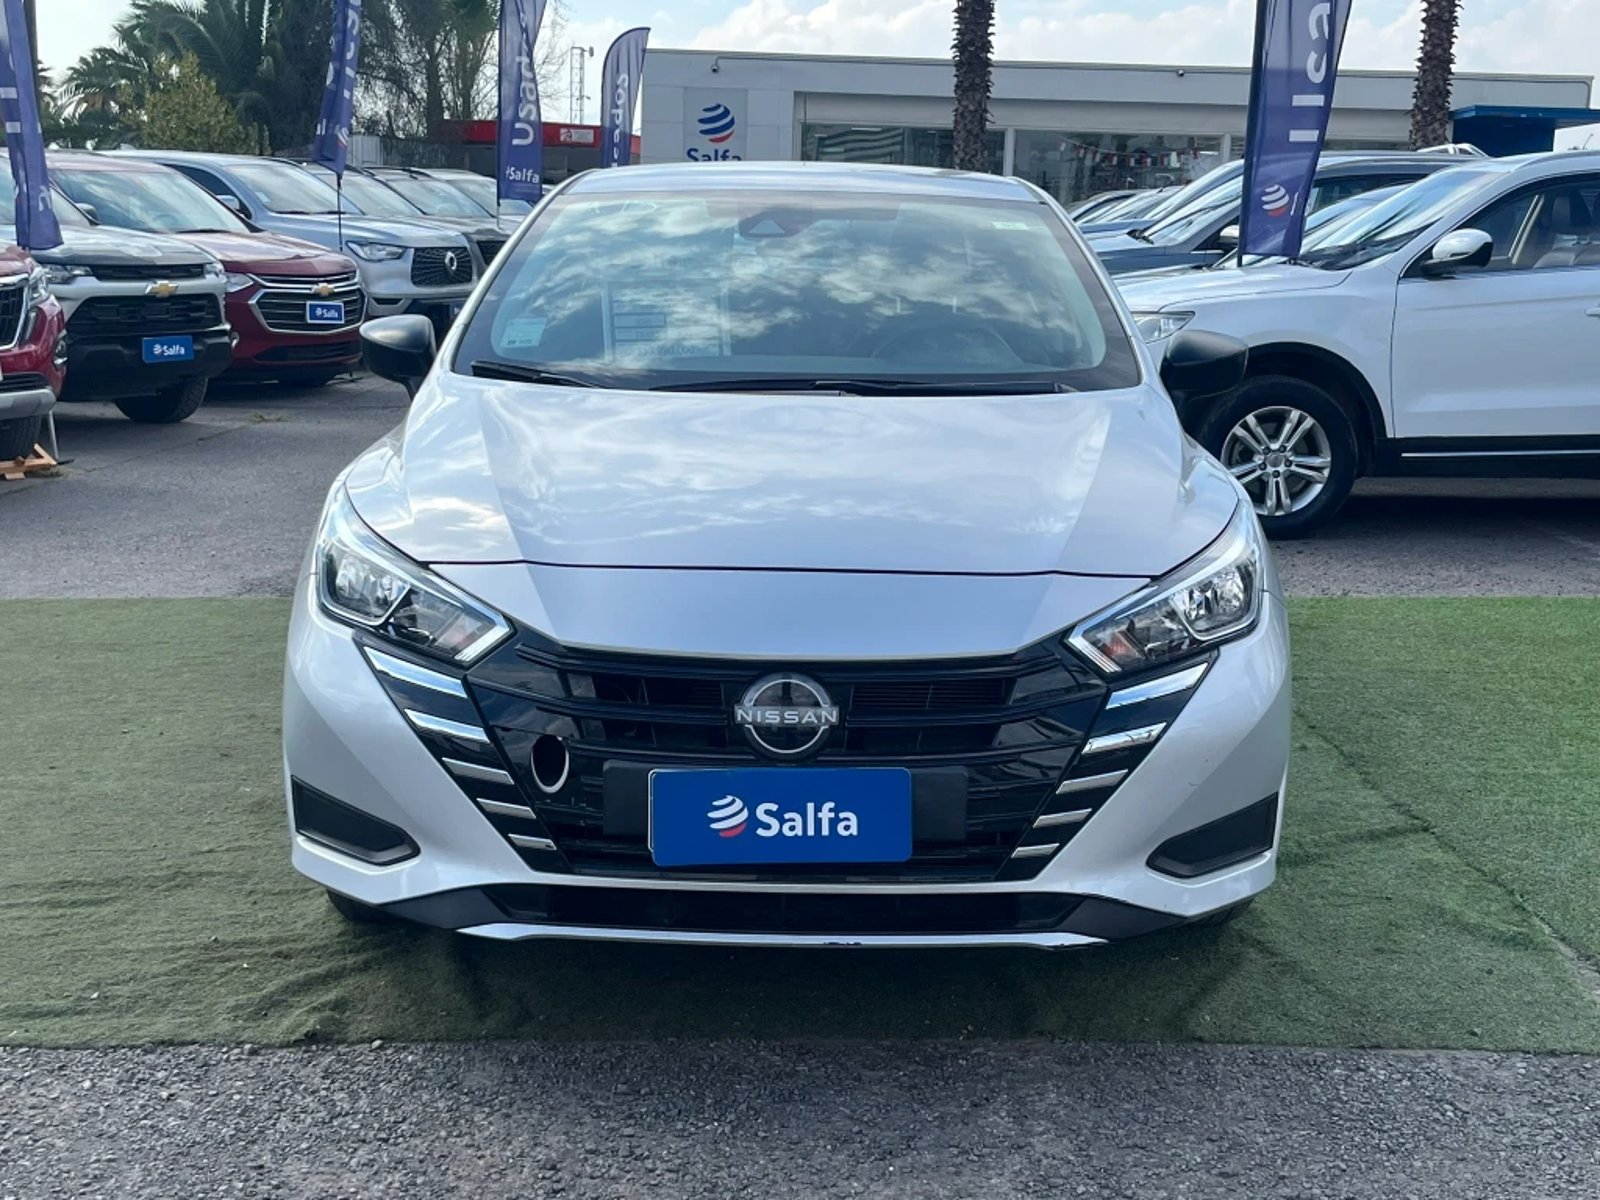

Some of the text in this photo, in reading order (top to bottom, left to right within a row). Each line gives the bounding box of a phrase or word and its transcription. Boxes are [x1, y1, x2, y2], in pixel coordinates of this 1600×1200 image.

[509, 166, 540, 184] Salfa
[163, 344, 185, 356] Salfa
[736, 707, 838, 724] NISSAN
[755, 801, 858, 837] Salfa
